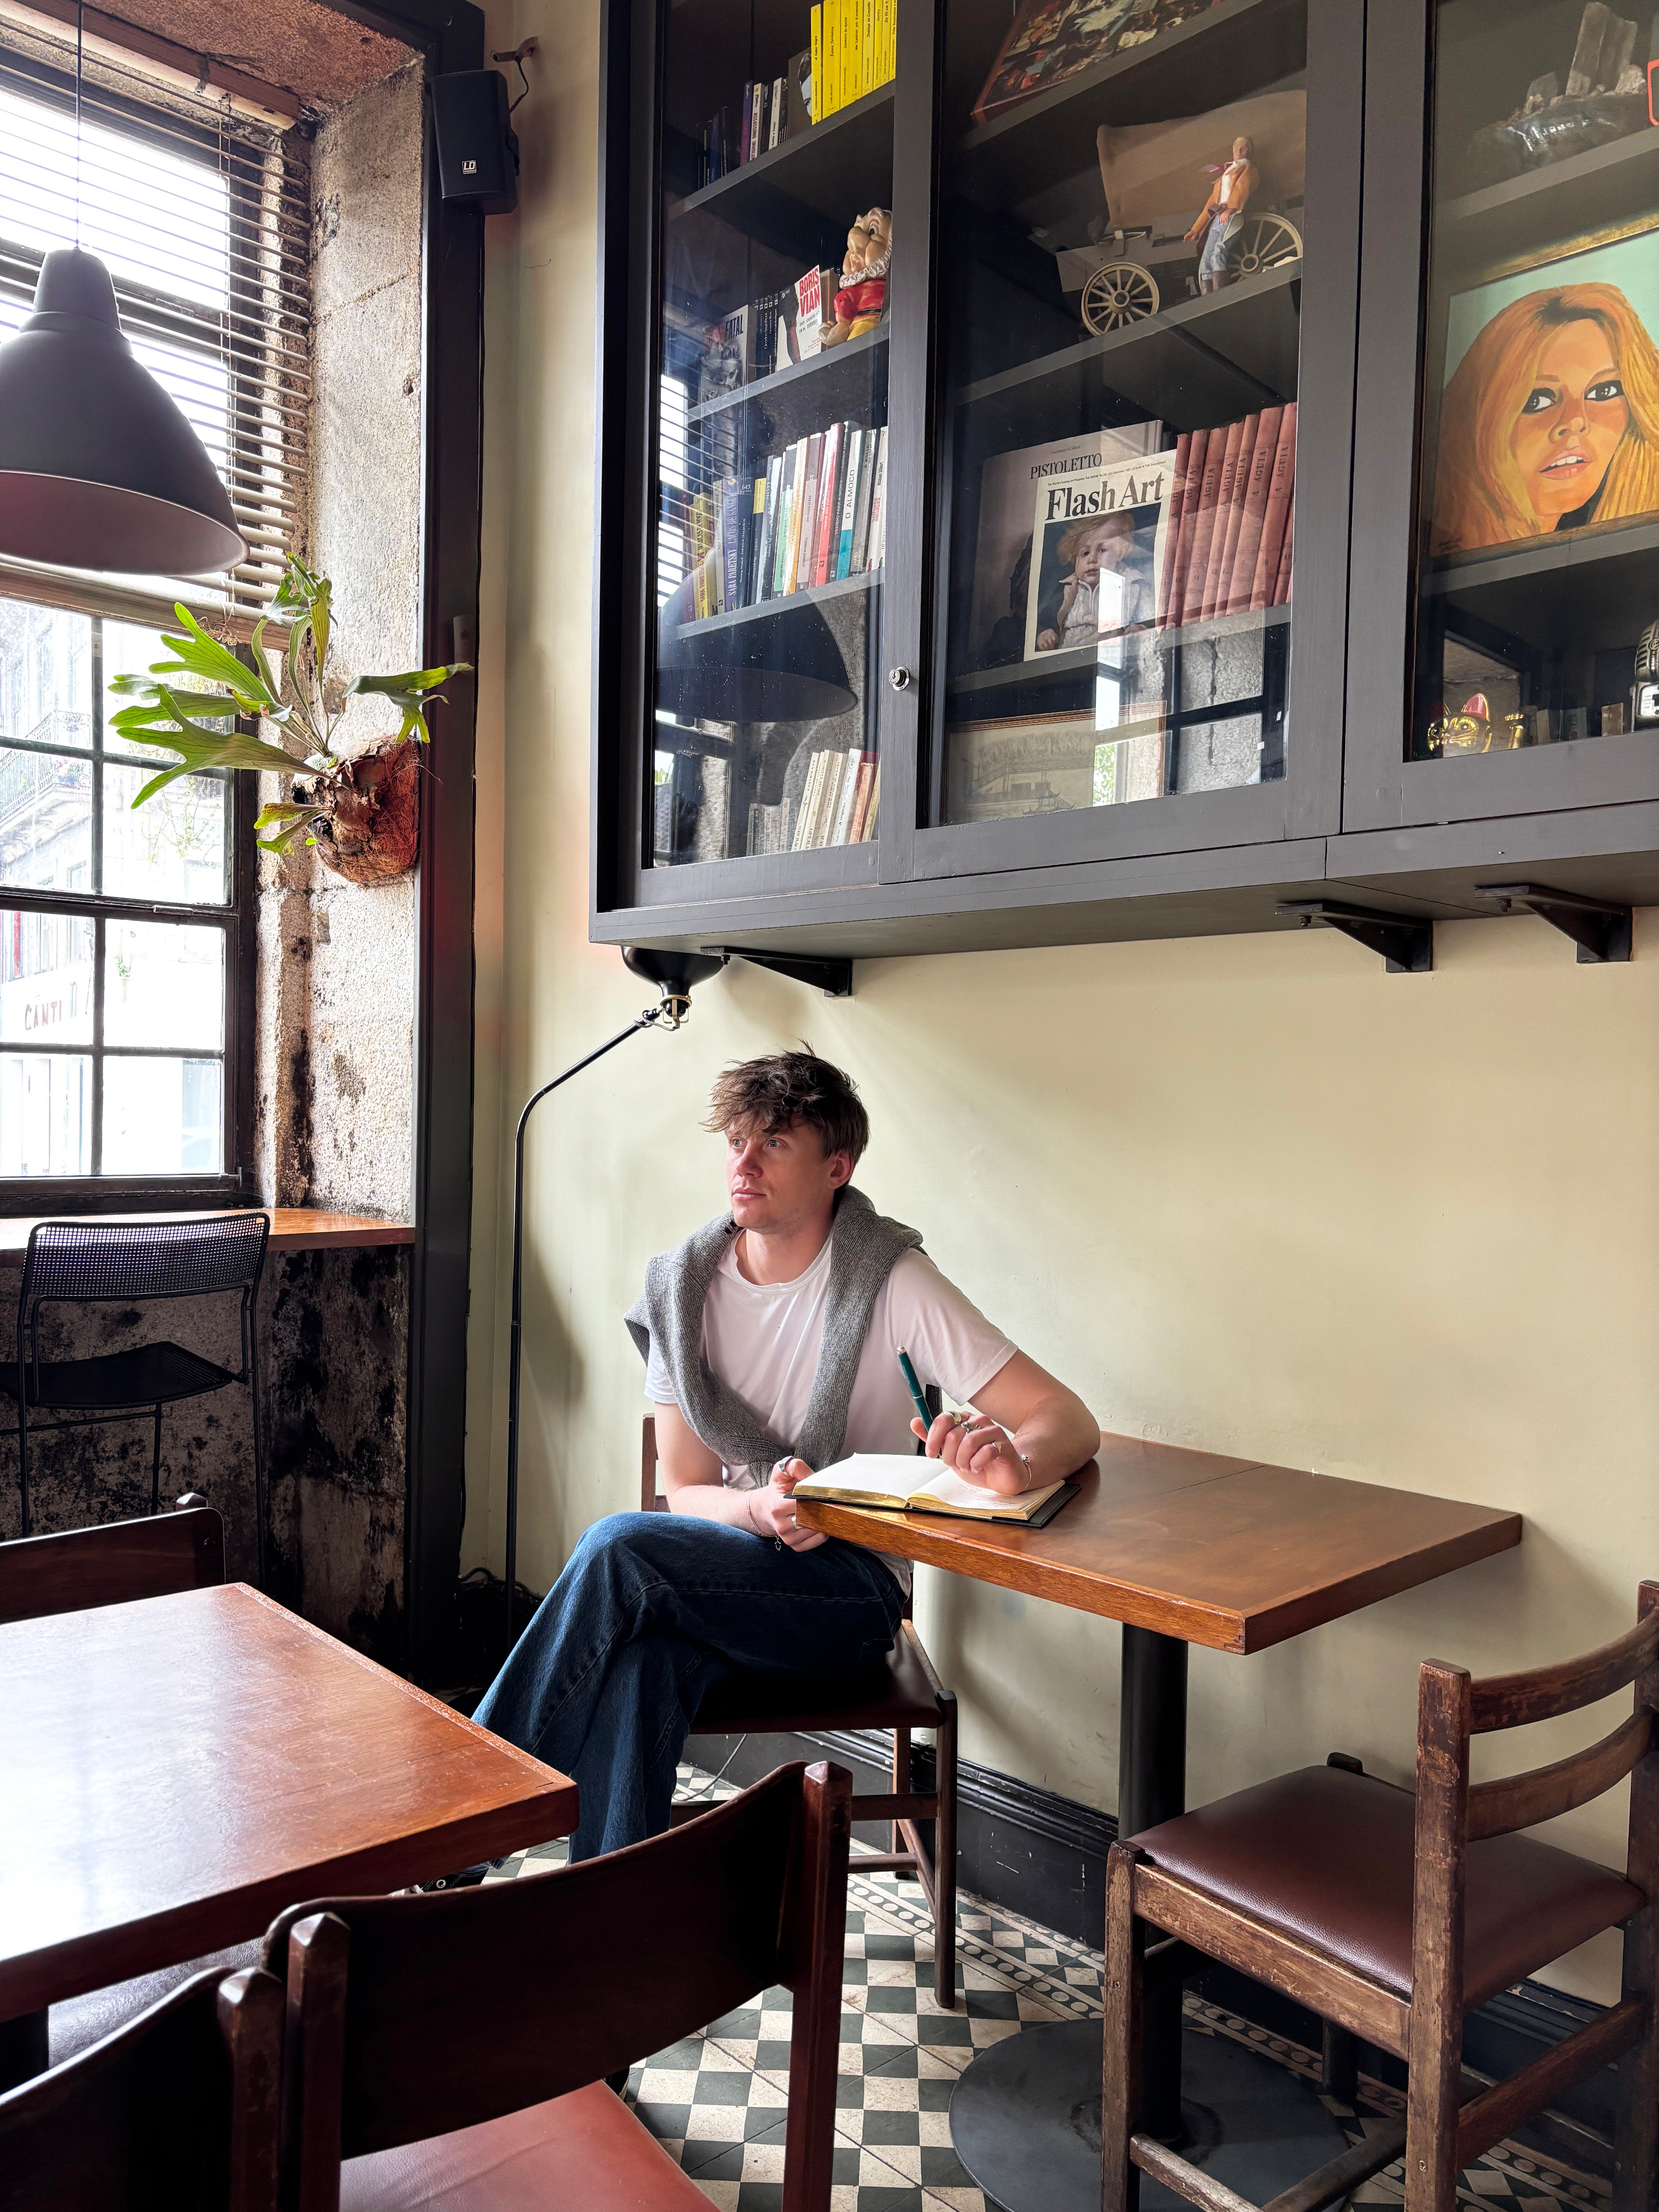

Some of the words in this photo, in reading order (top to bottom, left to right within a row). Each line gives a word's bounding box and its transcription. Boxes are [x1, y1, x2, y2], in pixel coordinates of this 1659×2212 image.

[464, 161, 475, 170] LD
[799, 267, 819, 297] BORIS
[800, 284, 821, 318] VIAN
[1030, 453, 1102, 479] PISTOLETTO
[1044, 480, 1115, 520] Flash
[1118, 471, 1164, 508] Art
[727, 549, 737, 579] PARETSKY
[728, 579, 736, 596] SARA
[25, 1000, 62, 1030] CANTI
